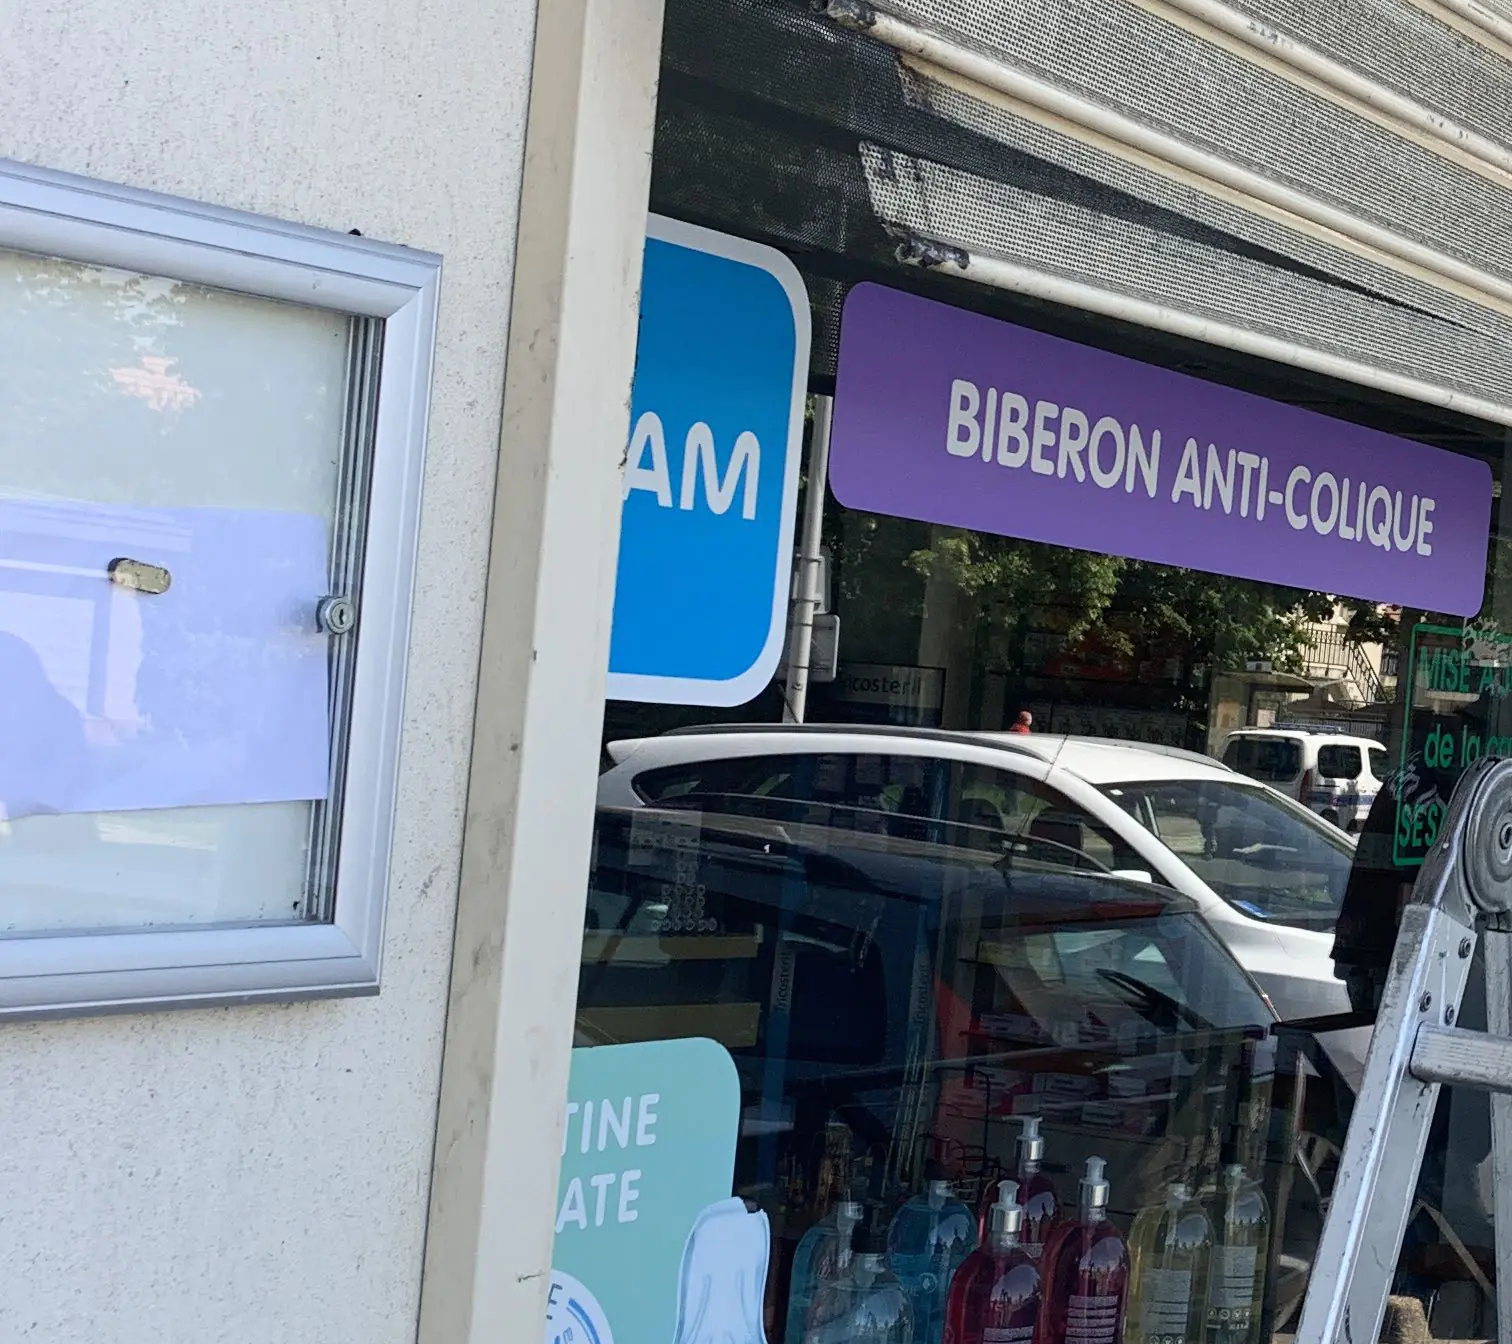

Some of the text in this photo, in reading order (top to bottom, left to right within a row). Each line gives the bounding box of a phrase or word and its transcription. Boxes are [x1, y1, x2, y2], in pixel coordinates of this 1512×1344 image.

[946, 379, 1437, 556] BIBERON ANTI-COLIQUE
[1424, 724, 1455, 768] de
[1462, 724, 1481, 767] la
[1399, 803, 1447, 847] SES
[555, 1169, 642, 1234] ATE
